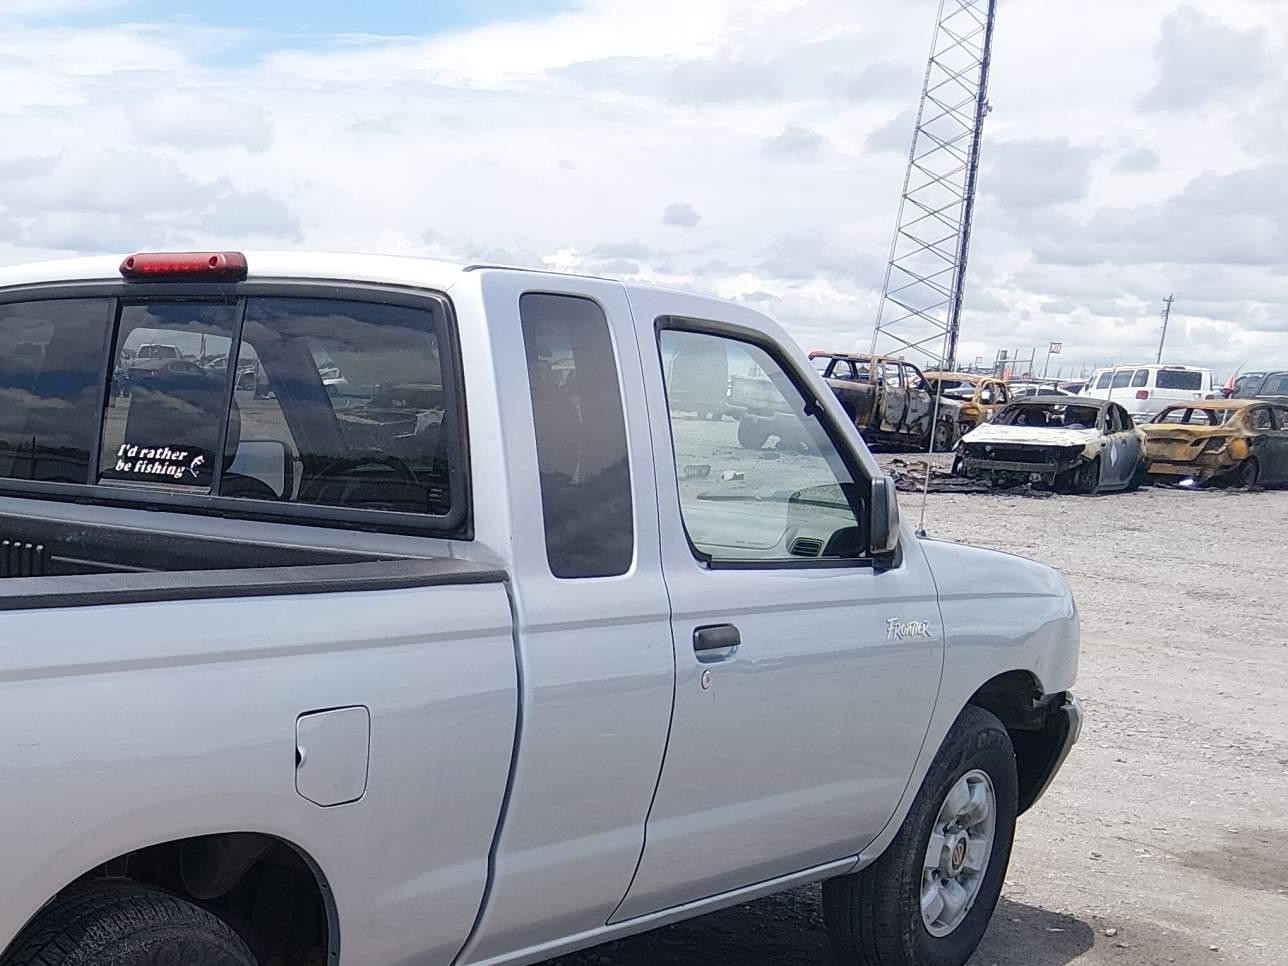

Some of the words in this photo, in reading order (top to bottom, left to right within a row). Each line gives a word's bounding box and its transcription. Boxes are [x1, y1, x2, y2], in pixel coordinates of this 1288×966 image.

[118, 444, 138, 457] I'd
[139, 447, 188, 461] rather
[115, 459, 132, 472] be
[133, 460, 185, 479] fishing
